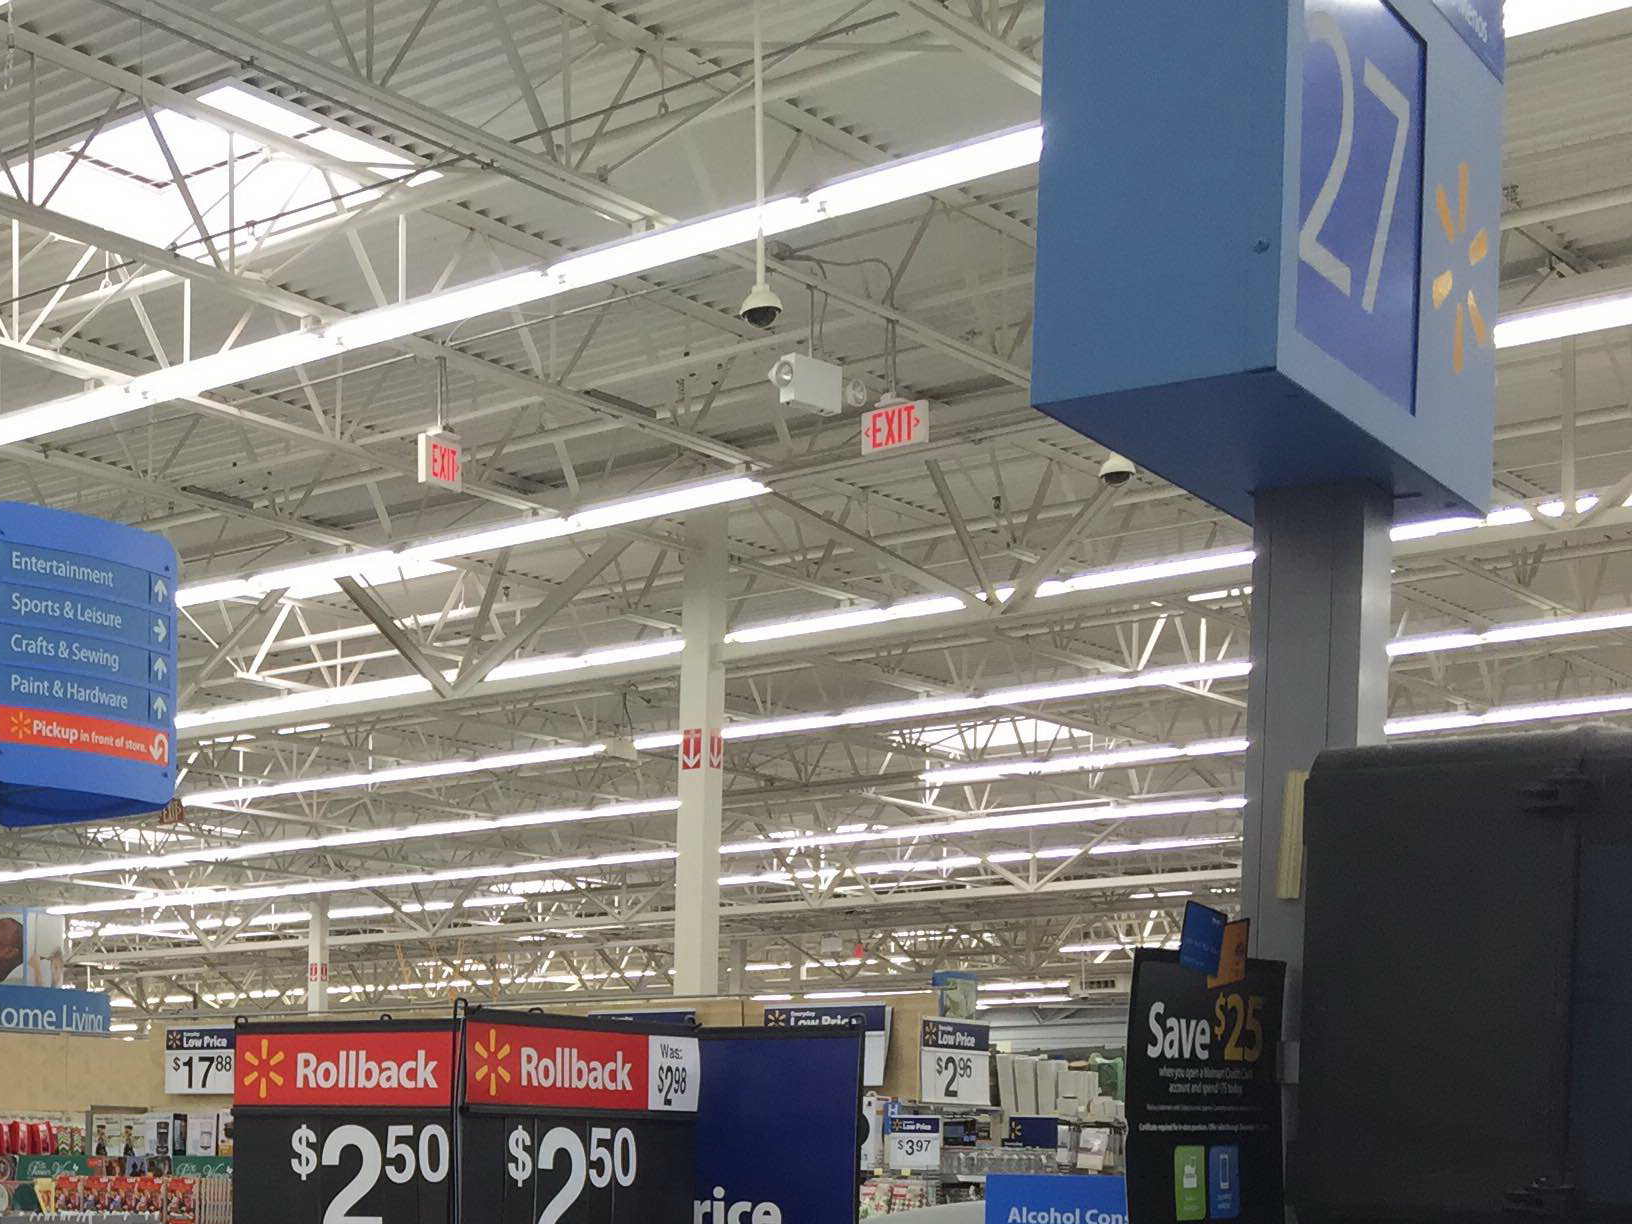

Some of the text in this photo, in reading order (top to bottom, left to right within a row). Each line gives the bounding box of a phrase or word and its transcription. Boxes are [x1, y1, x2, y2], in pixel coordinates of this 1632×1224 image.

[1299, 10, 1410, 314] 27
[872, 405, 915, 448] EXIT
[431, 444, 456, 478] EXIT
[11, 551, 114, 588] Entertainment
[11, 592, 122, 629] Sports & Leisure
[11, 634, 120, 671] Crafts & Sewing
[11, 674, 128, 710] Paint & Hardware
[63, 1005, 103, 1032] Living
[1146, 992, 1264, 1062] Save $25
[183, 1036, 227, 1048] Low Price
[660, 1043, 683, 1061] Was:
[938, 1031, 976, 1048] Low Price
[296, 1050, 437, 1090] Rollback
[520, 1046, 633, 1092] Rollback
[916, 1123, 932, 1131] Price
